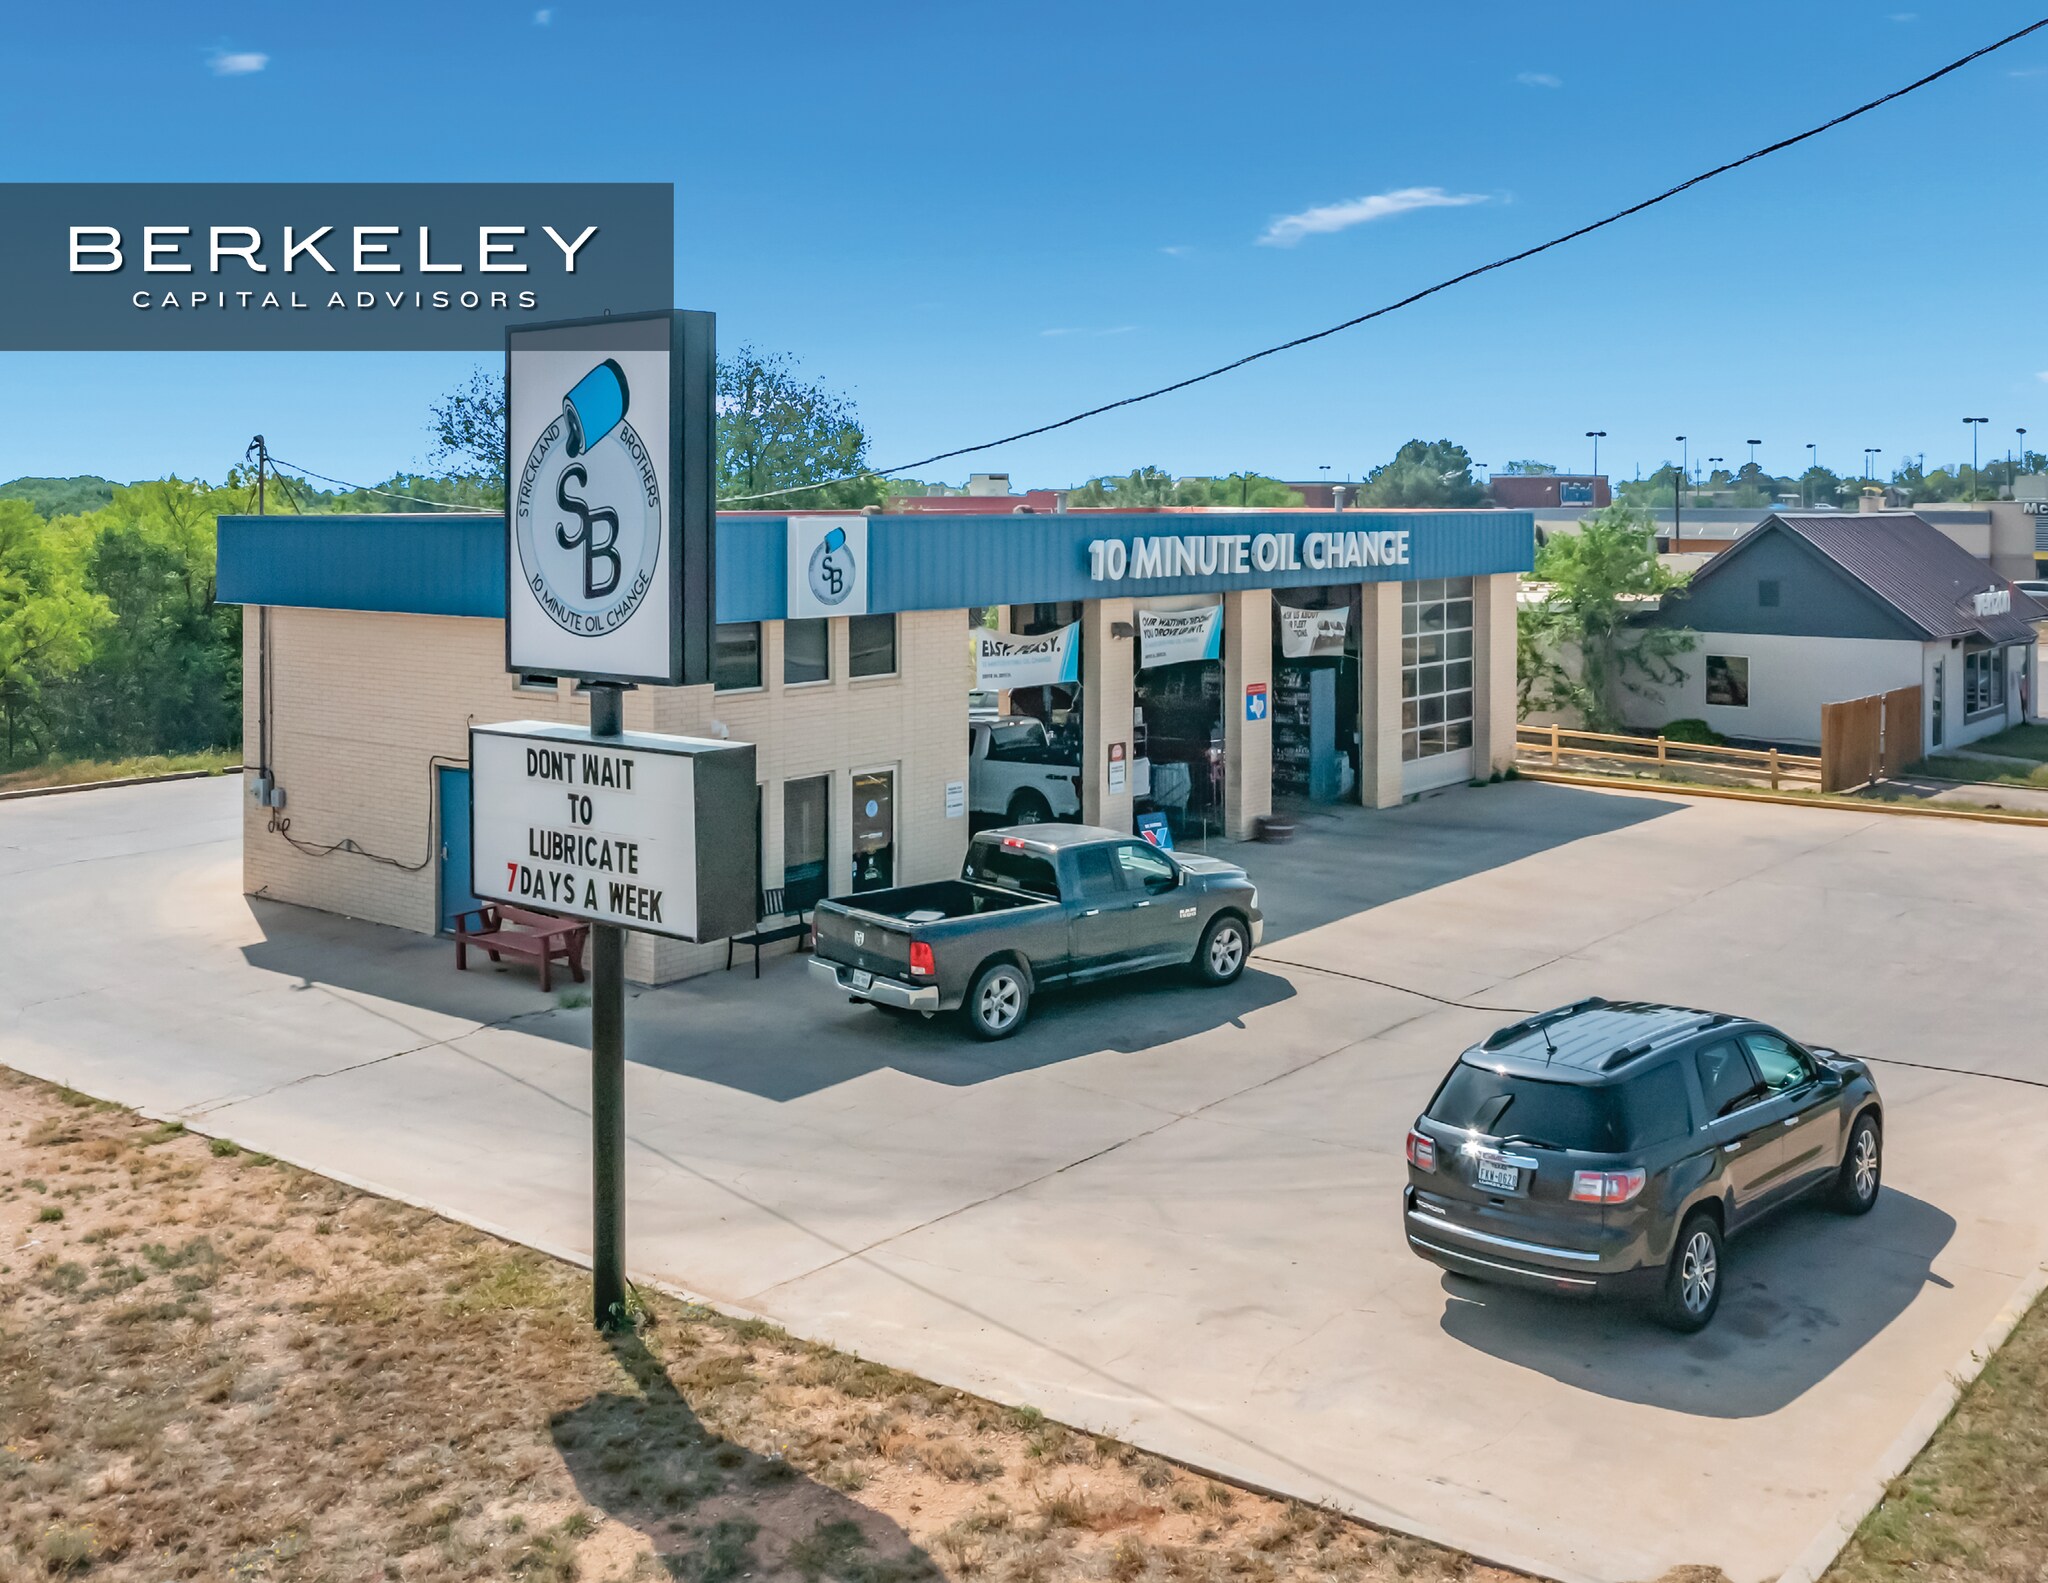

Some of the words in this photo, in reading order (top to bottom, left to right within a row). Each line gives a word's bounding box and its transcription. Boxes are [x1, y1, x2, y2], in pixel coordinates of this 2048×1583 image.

[519, 424, 561, 518] STRICKLAND
[619, 426, 659, 508] BROTHERS
[1088, 538, 1126, 581] 10
[1129, 535, 1250, 579] MINUTE
[1251, 532, 1301, 572] OIL
[1302, 530, 1410, 570] CHANGE
[531, 573, 544, 592] 10
[542, 590, 583, 632] MINUTE
[584, 615, 605, 632] OIL
[606, 568, 650, 628] CHANGE
[526, 747, 576, 784] DONT
[582, 753, 634, 790] WAIT
[567, 793, 593, 826] TO
[529, 828, 639, 875] LUBRICATE
[584, 878, 598, 911] A
[609, 881, 663, 924] WEEK
